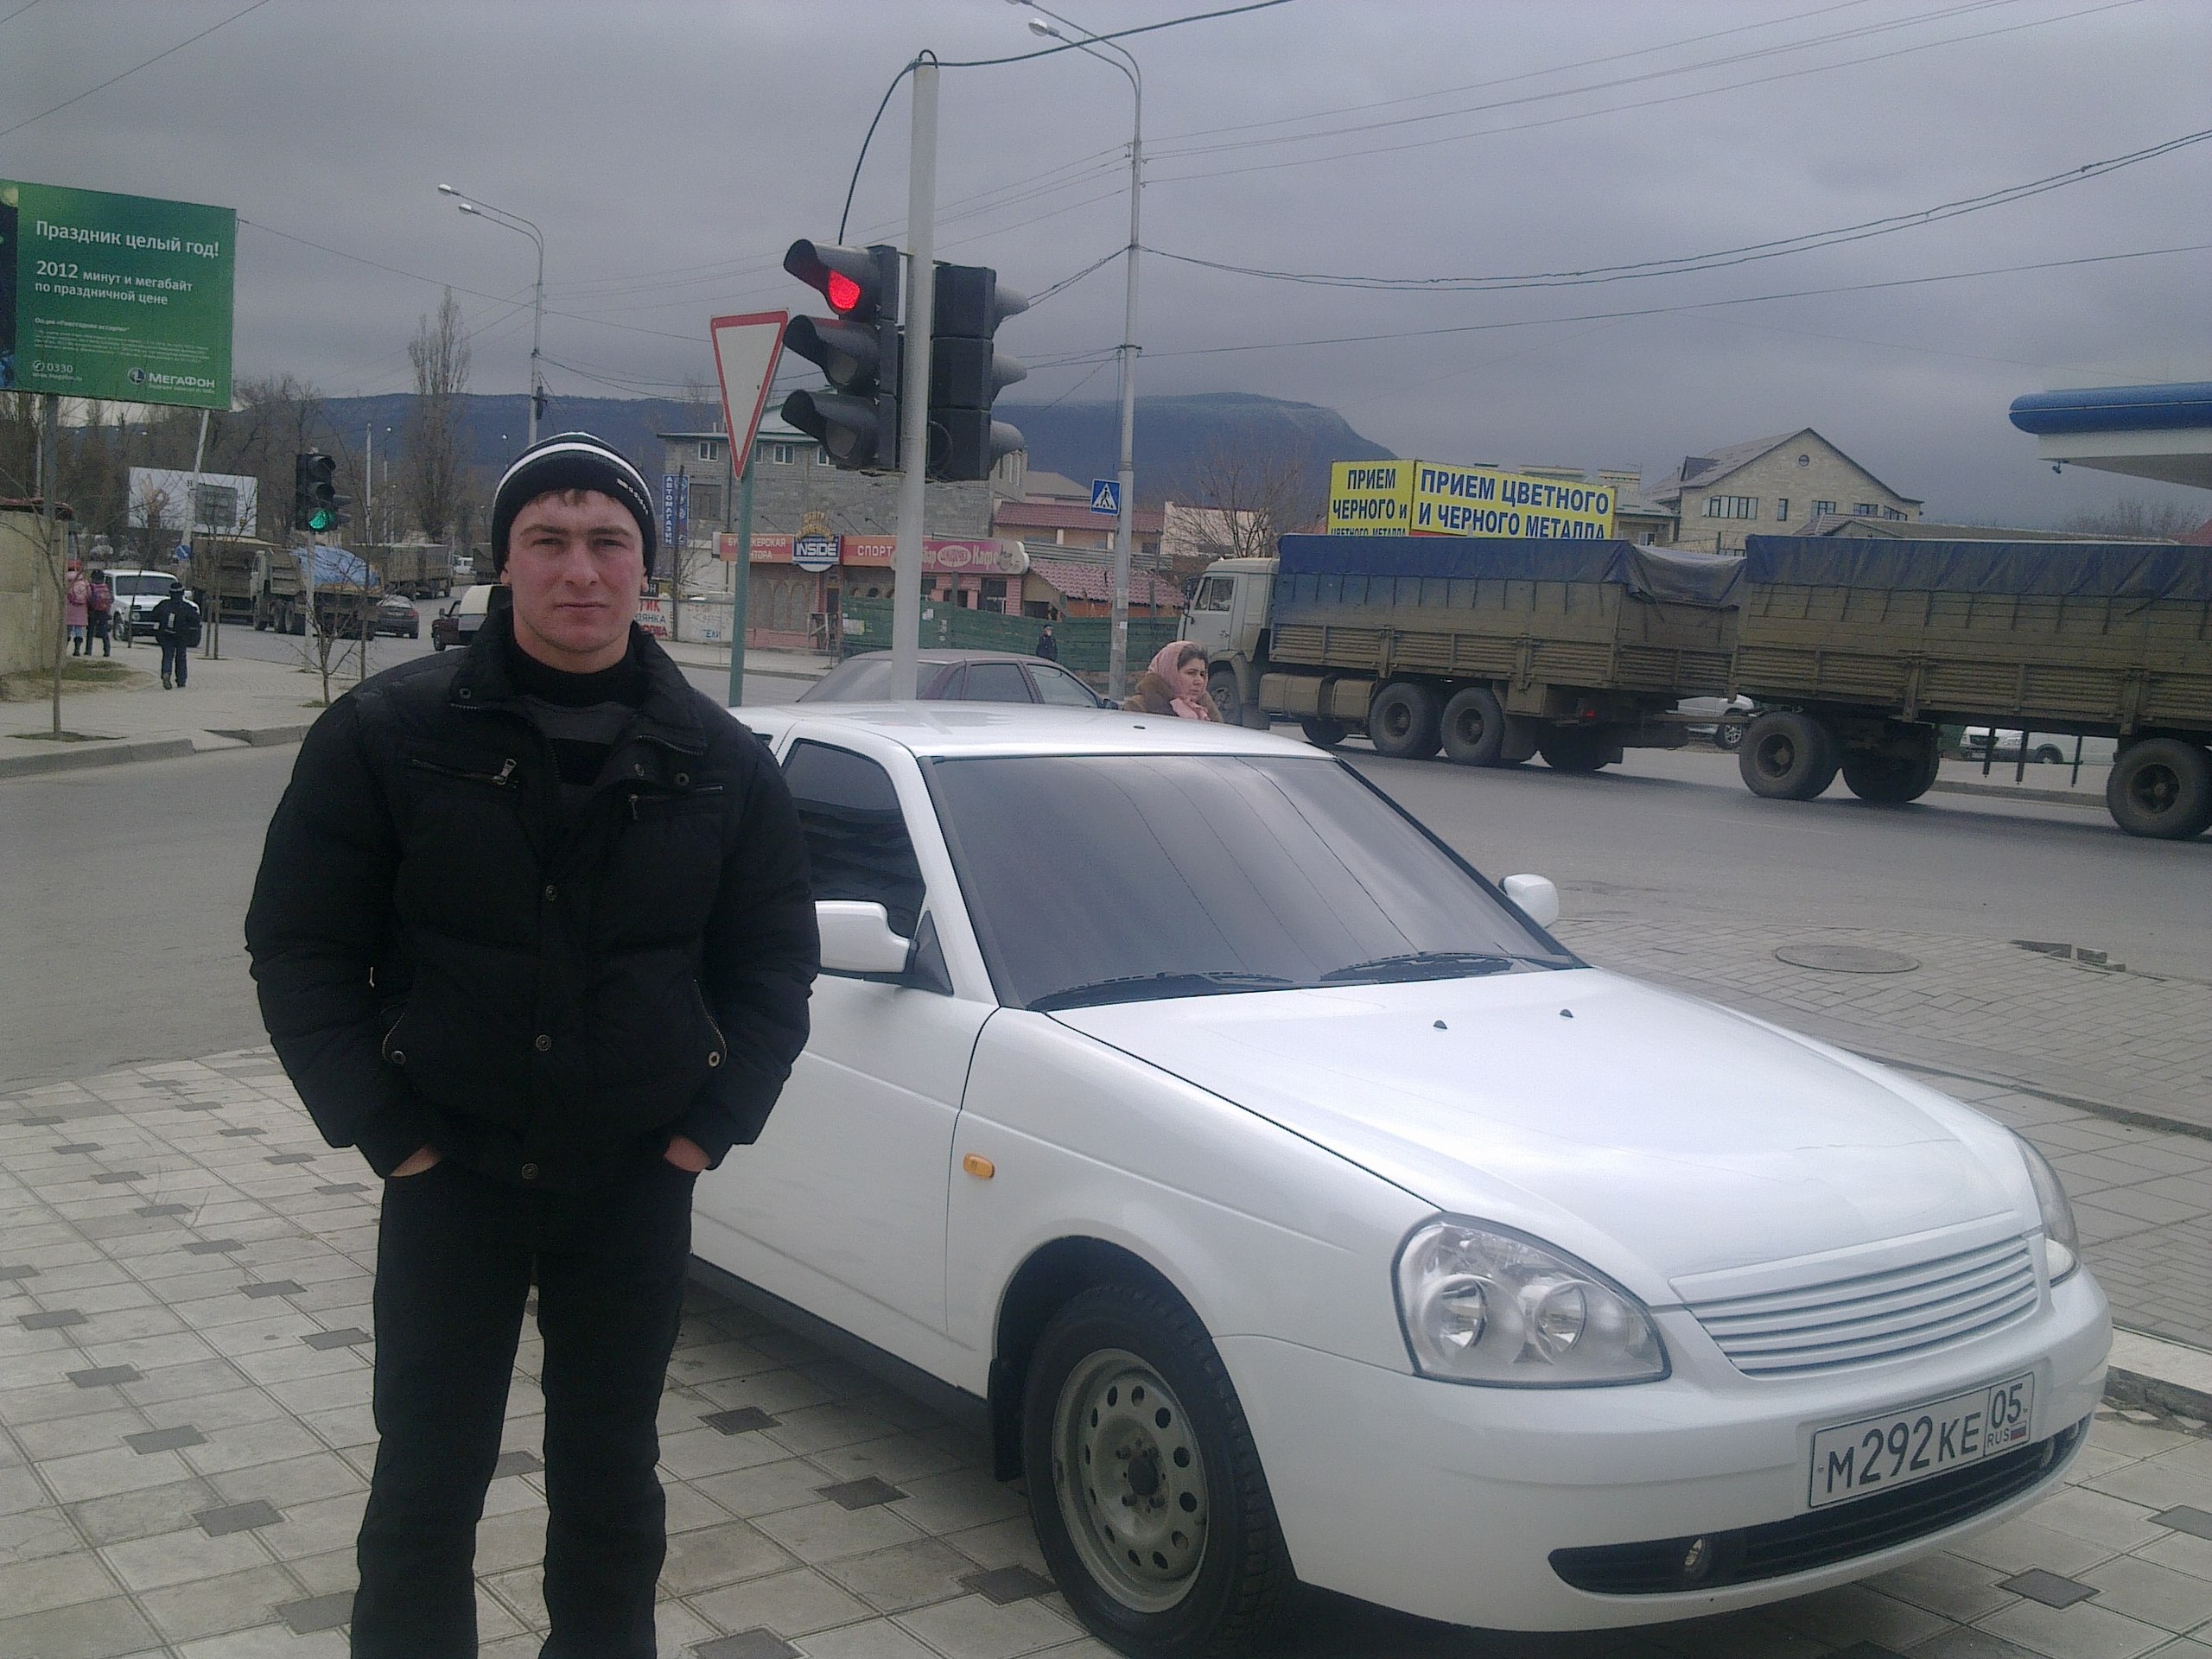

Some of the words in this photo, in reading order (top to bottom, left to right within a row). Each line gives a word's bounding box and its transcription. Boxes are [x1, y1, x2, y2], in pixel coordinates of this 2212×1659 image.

[36, 220, 121, 245] Праздник
[125, 234, 181, 252] целый
[186, 241, 219, 259] год!
[36, 260, 79, 279] 2012
[83, 271, 121, 285] минут
[124, 276, 131, 285] и
[135, 276, 194, 292] мегабайт
[35, 282, 50, 292] по
[54, 283, 136, 302] праздничной
[138, 293, 168, 305] цене
[47, 363, 73, 373] 0330
[1347, 468, 1396, 491] ПРИЕМ
[1421, 469, 1496, 501] ПРИЕМ
[1501, 478, 1609, 516] ЦВЕТНОГО
[664, 476, 673, 544] АВТОМАГАЗИН
[1333, 499, 1395, 520] ЧЕРНОГО
[1418, 503, 1432, 526] И
[1438, 504, 1520, 536] ЧЕРНОГО
[1525, 516, 1605, 539] МЕТАЛЛА
[796, 542, 837, 556] INSIDE
[857, 545, 893, 556] СПОРТ
[1827, 1412, 1981, 1493] М292КЕ
[1991, 1382, 2023, 1429] 05
[1986, 1429, 2010, 1447] RUS
